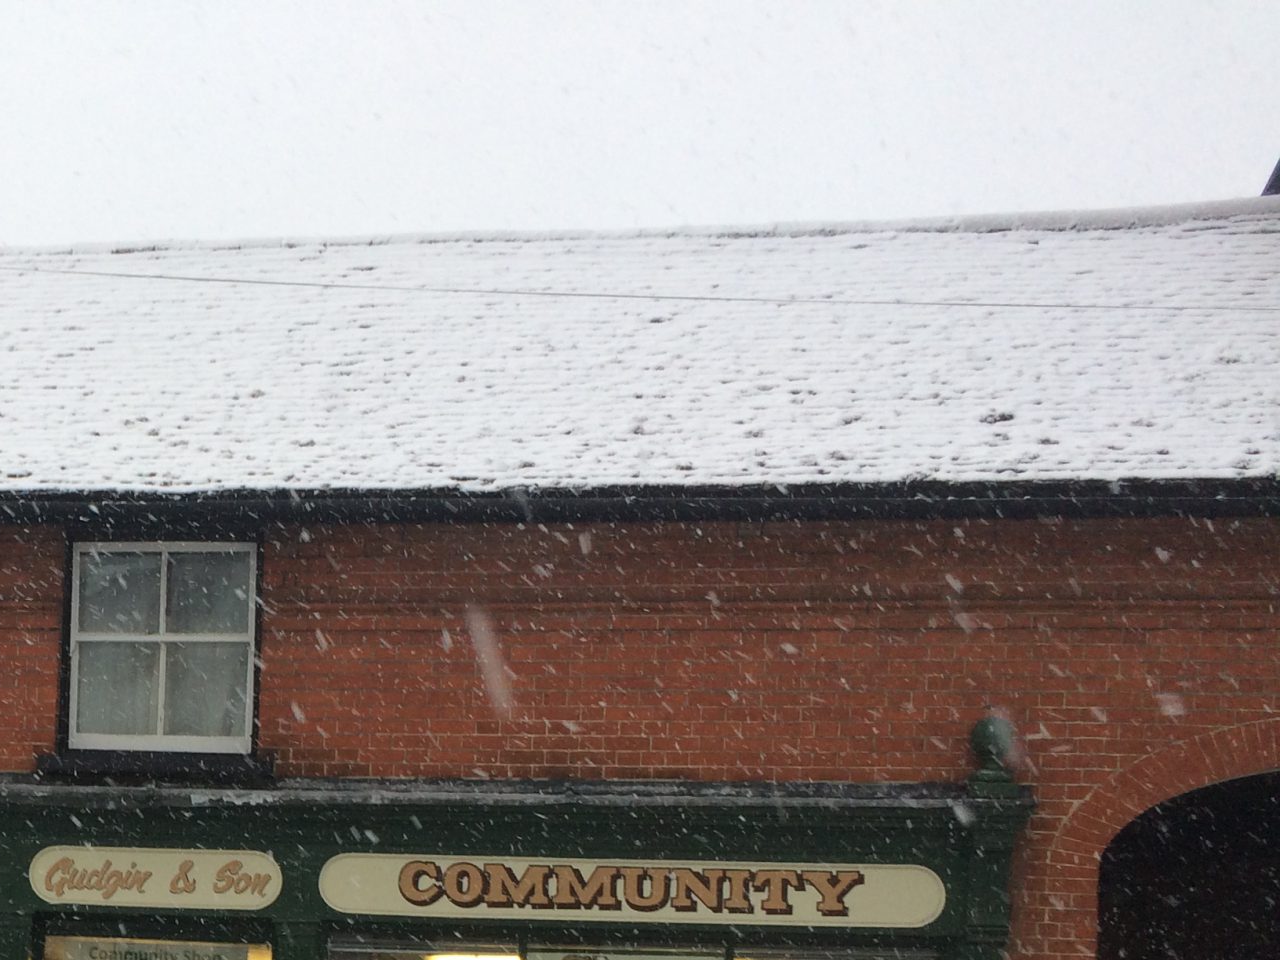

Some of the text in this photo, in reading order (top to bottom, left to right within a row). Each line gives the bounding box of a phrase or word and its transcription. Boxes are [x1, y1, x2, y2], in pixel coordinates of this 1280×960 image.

[44, 856, 272, 900] Gudgin & Son
[398, 859, 865, 917] COMMUNITY
